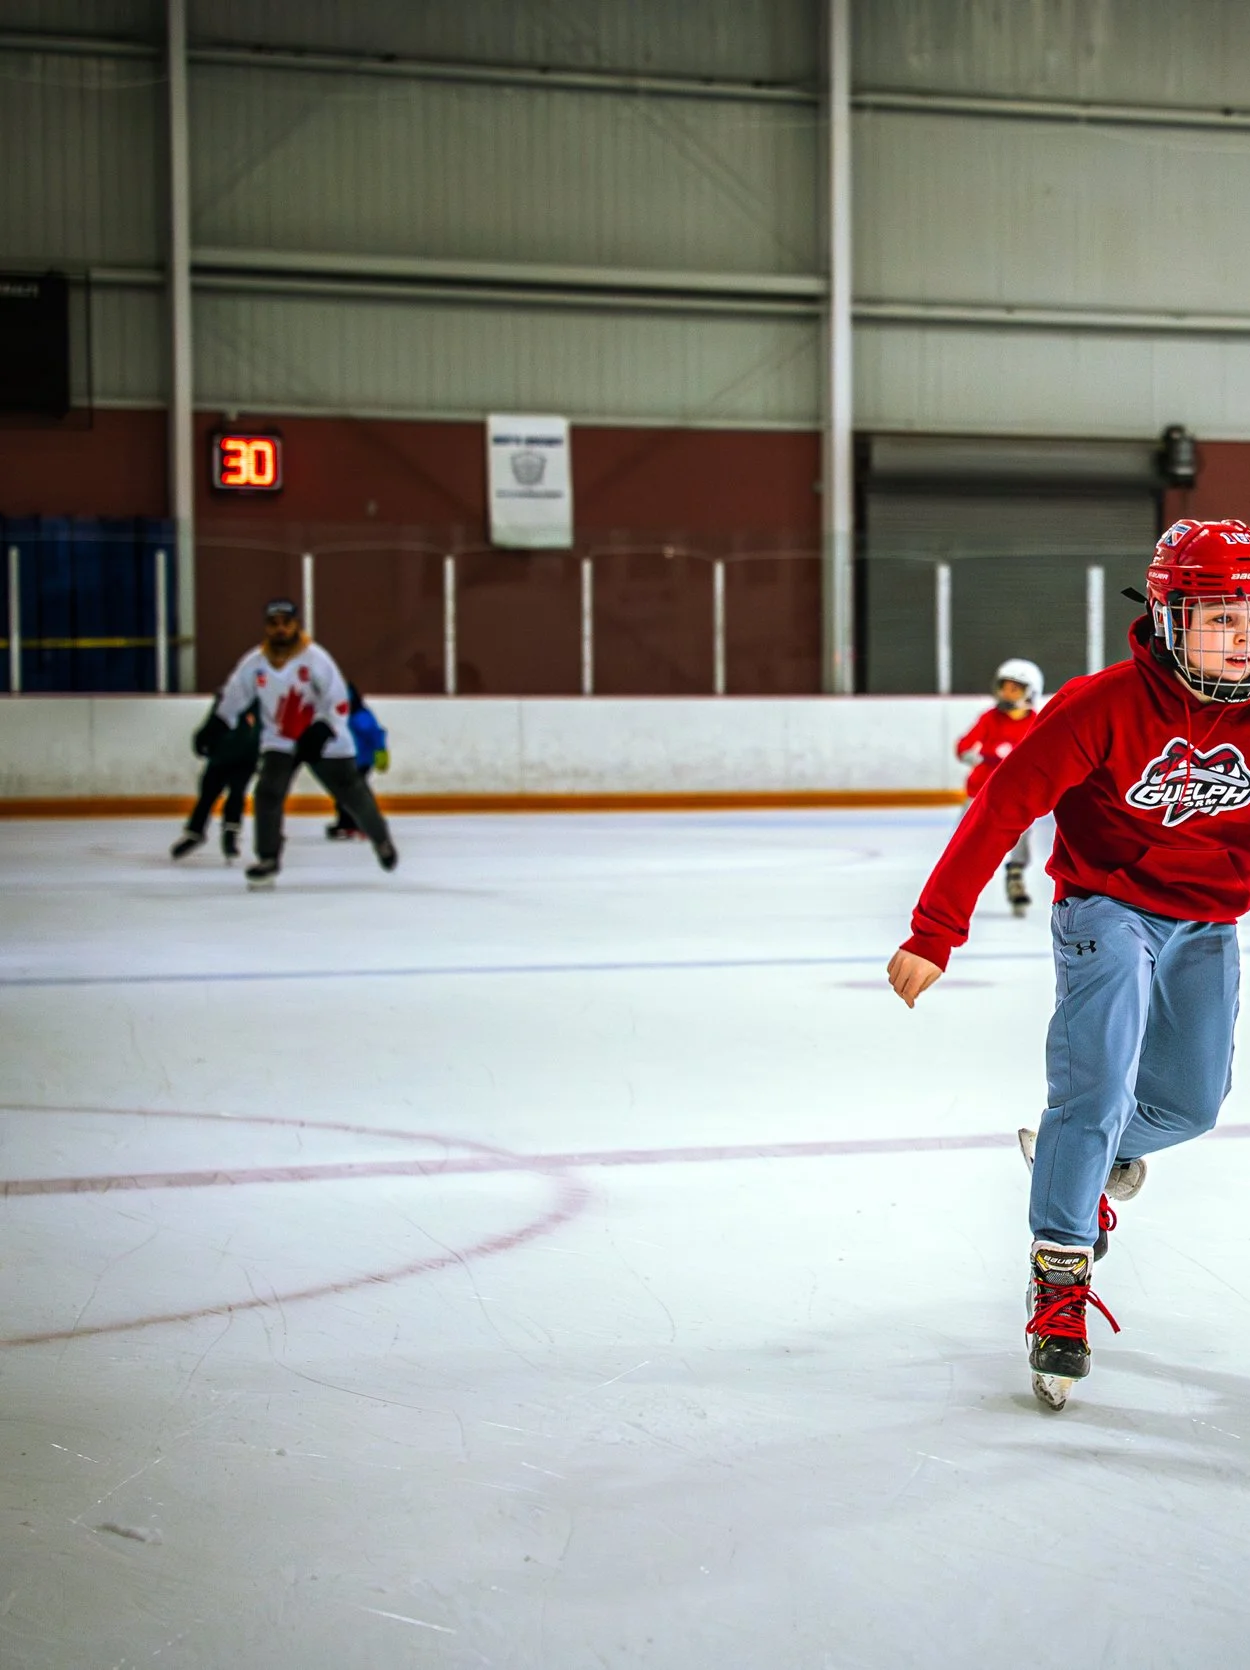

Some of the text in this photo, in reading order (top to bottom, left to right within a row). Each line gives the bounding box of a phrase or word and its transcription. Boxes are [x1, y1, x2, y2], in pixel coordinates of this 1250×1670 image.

[221, 437, 276, 485] 30
[1134, 783, 1250, 804] GUELPH
[1043, 1255, 1080, 1265] BAUER
